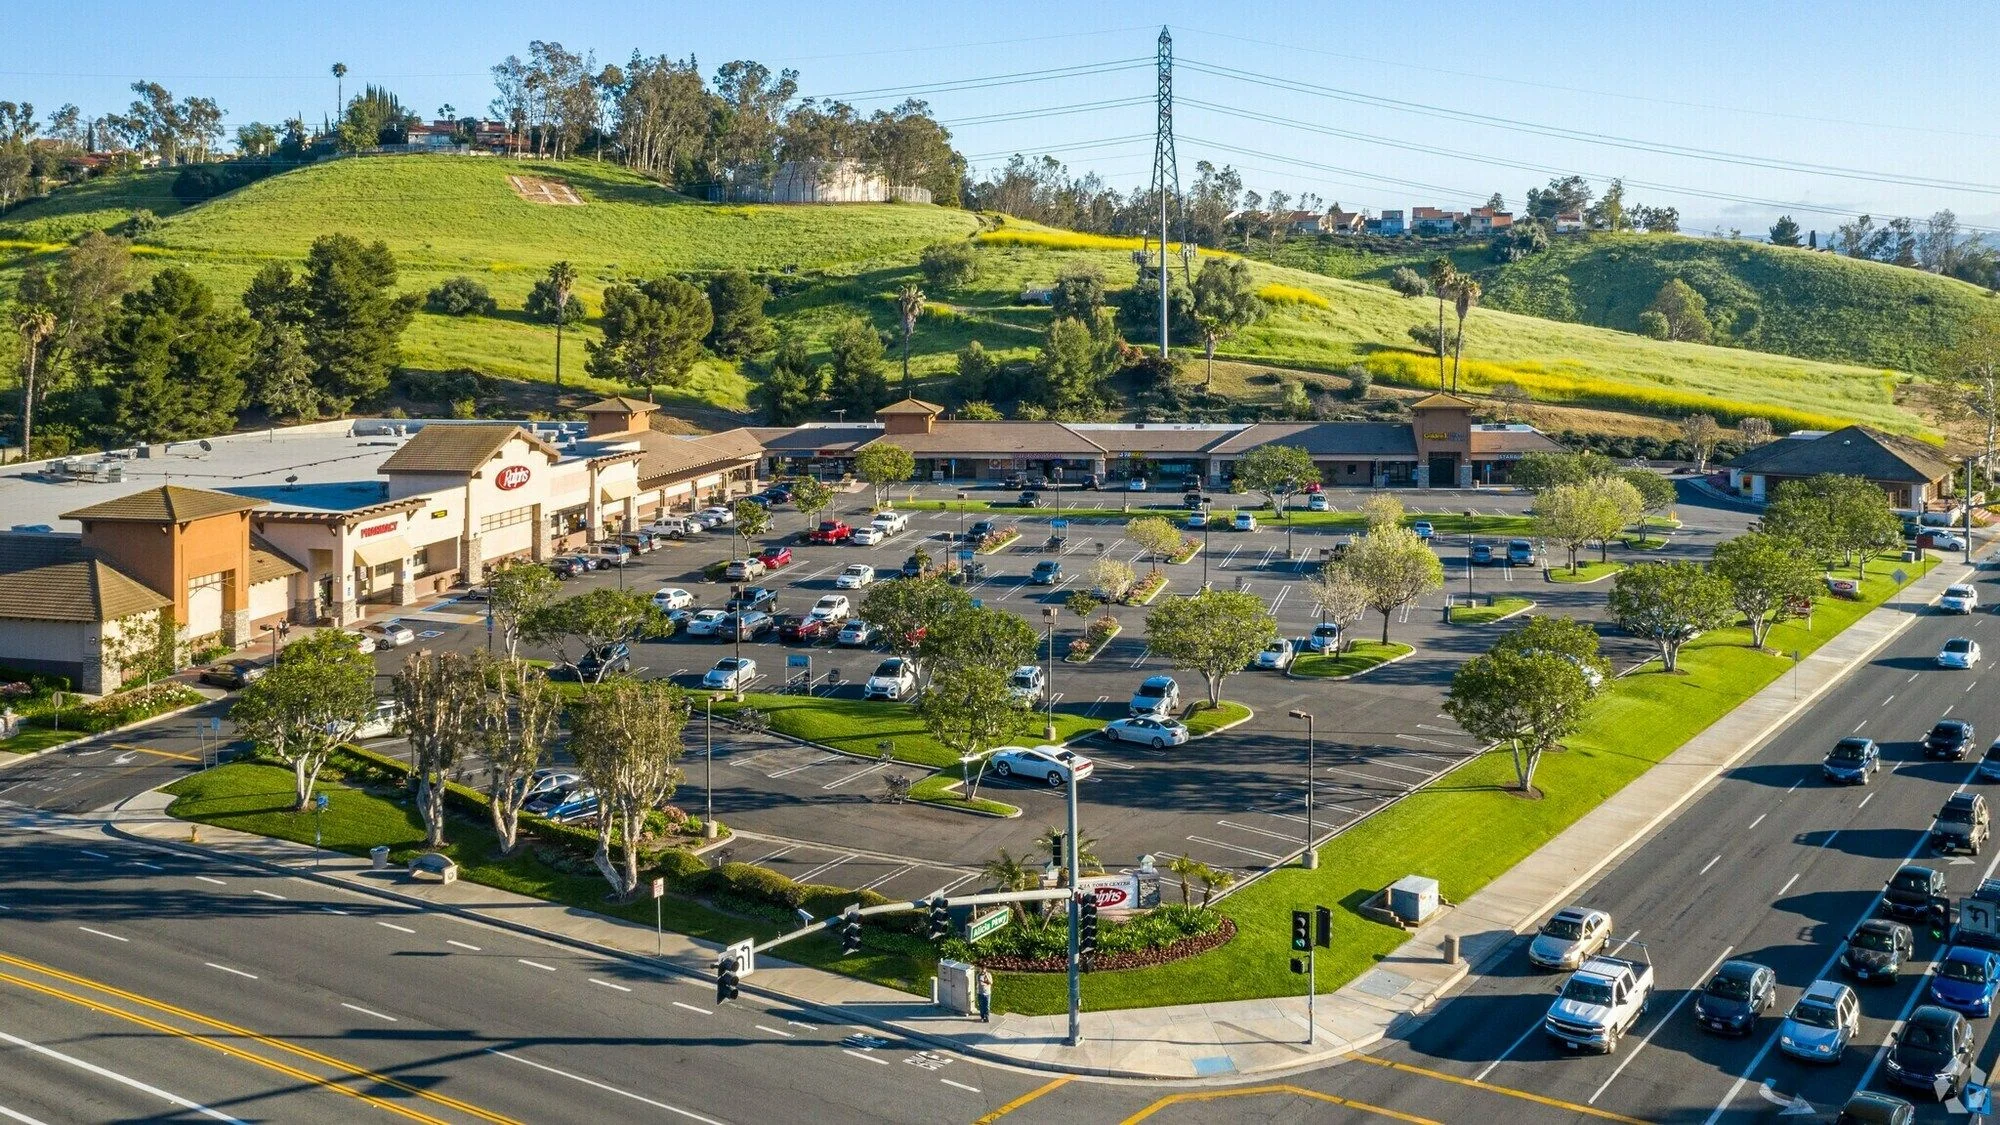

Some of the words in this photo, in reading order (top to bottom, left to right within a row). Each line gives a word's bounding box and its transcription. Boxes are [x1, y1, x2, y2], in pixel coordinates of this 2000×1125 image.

[503, 467, 530, 488] Ralphs
[360, 521, 398, 539] PHARMACY
[973, 923, 990, 938] Alicia
[991, 914, 1007, 928] Pkwy
